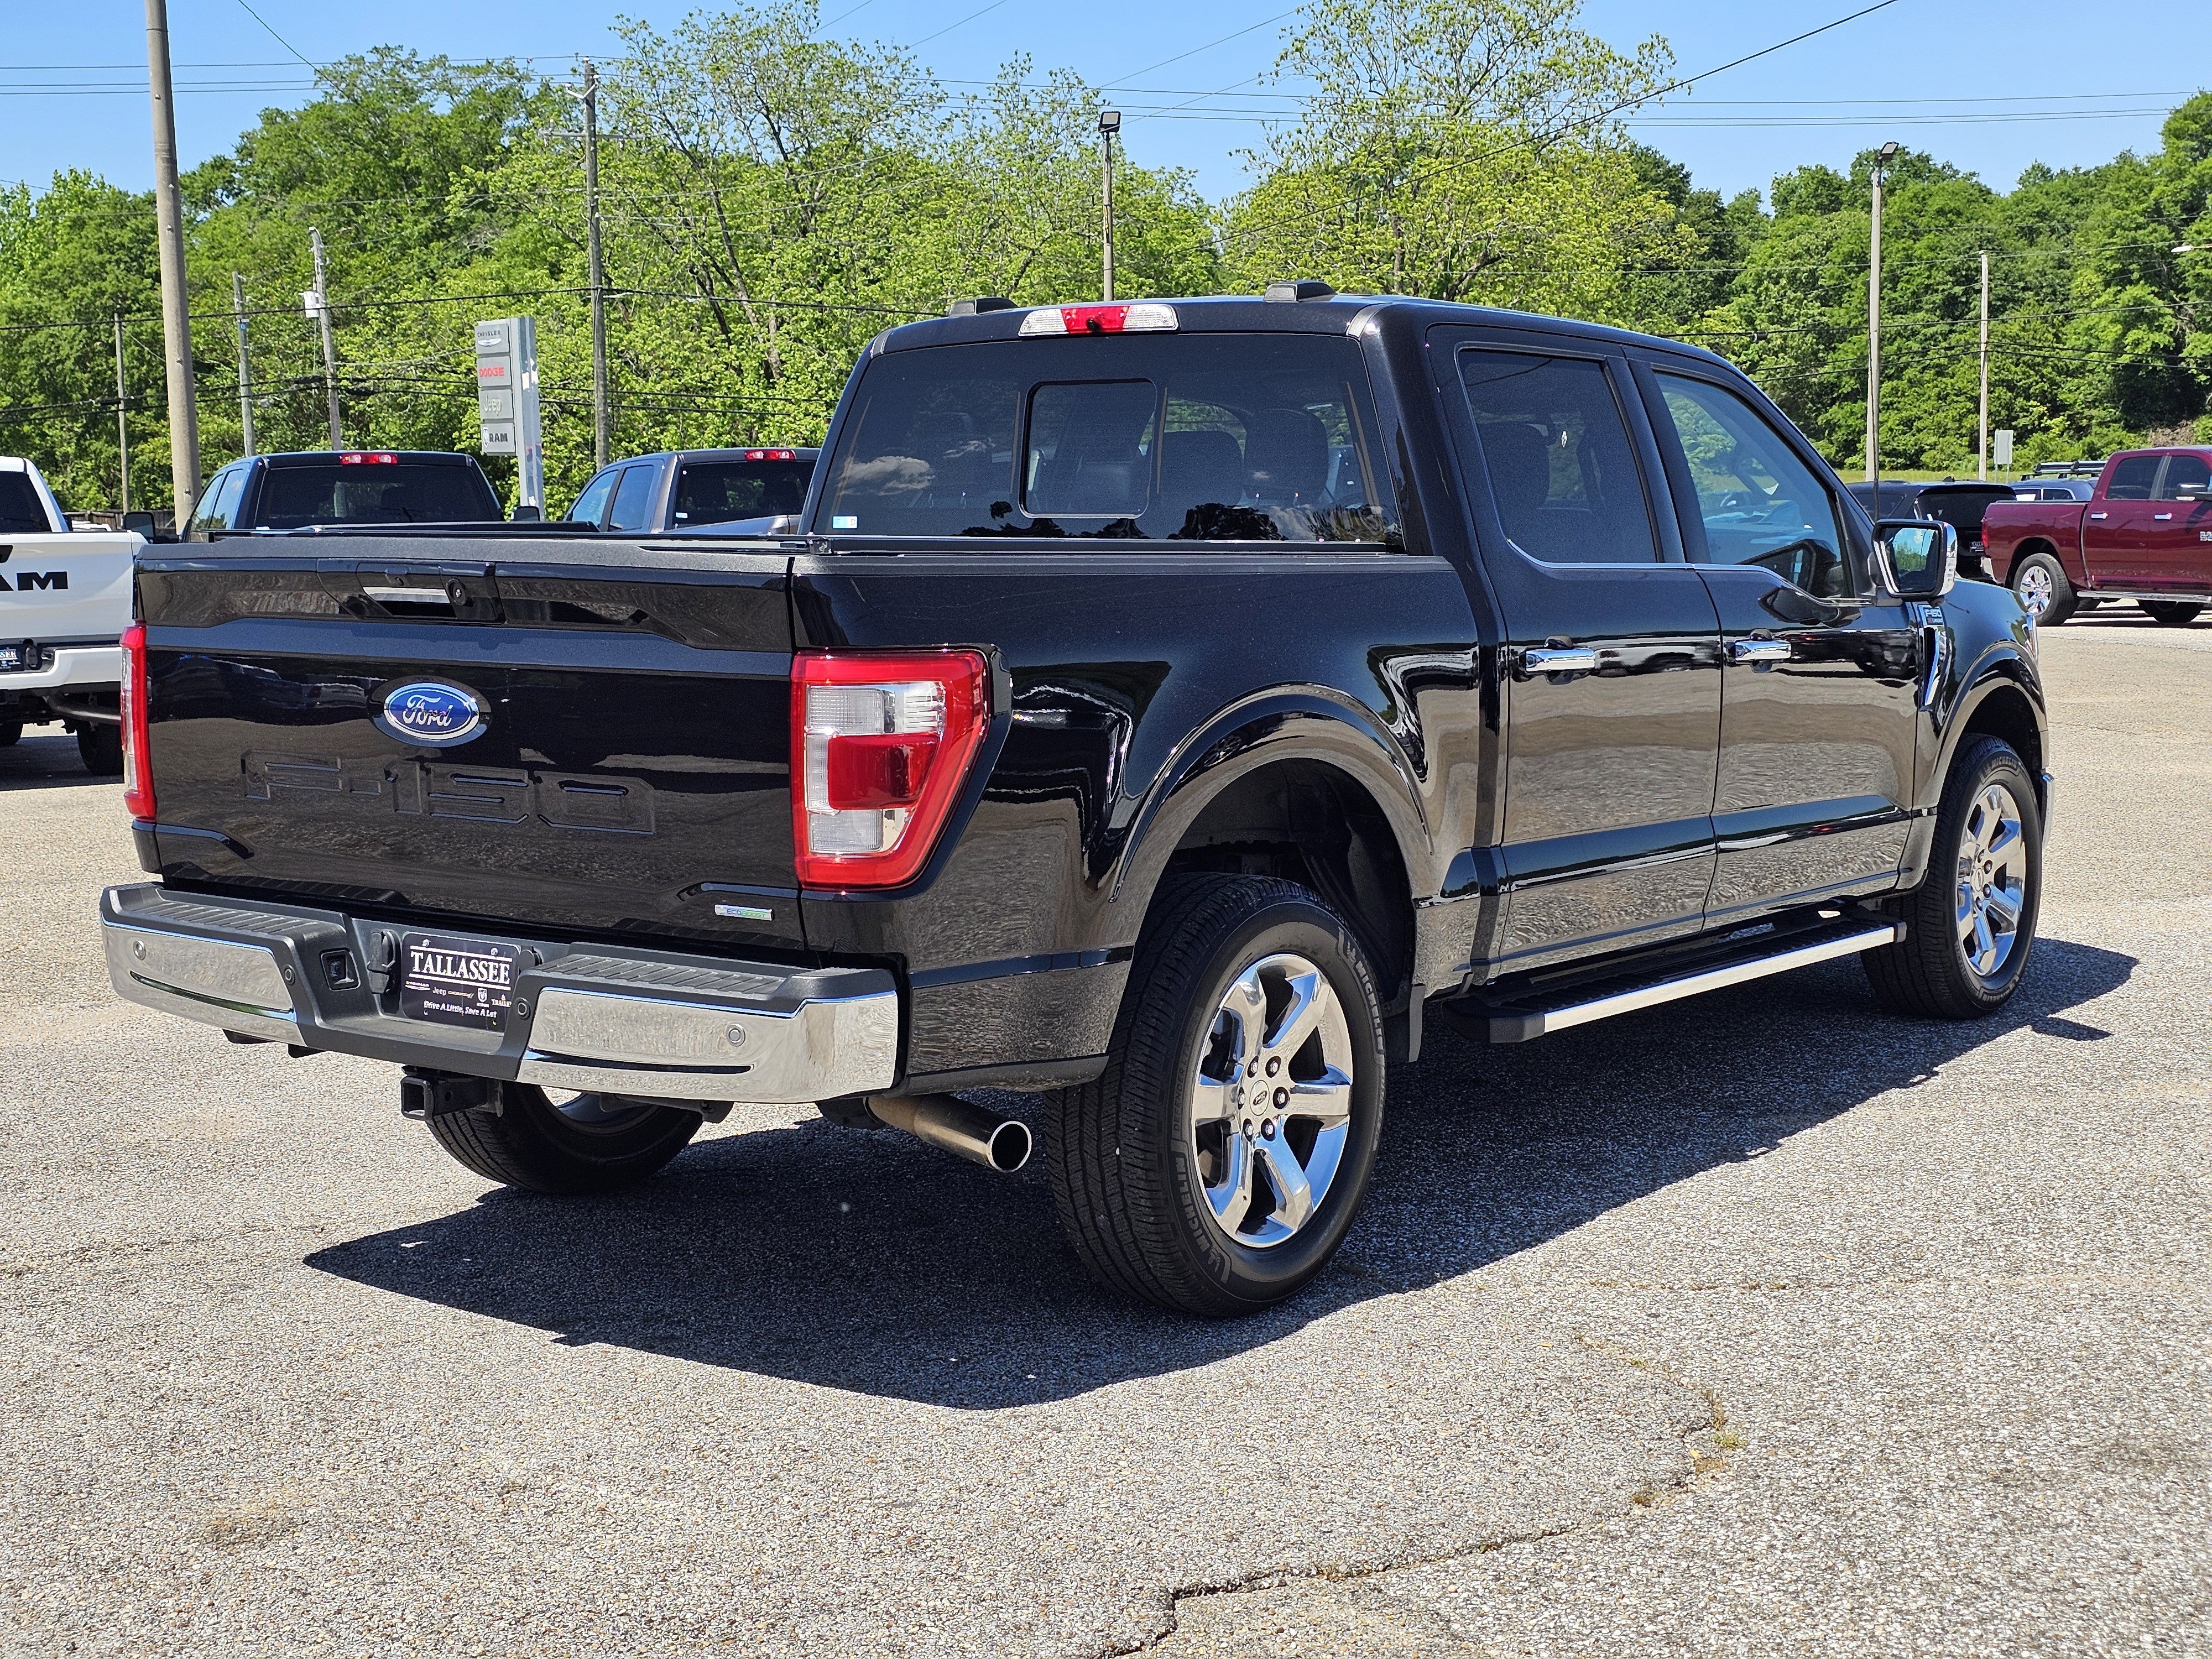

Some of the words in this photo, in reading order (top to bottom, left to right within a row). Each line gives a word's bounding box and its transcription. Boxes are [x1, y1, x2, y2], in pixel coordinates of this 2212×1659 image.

[479, 367, 504, 377] DODGE
[484, 395, 502, 416] Jeep
[489, 433, 508, 442] RAM
[402, 694, 453, 727] Ford
[241, 748, 655, 836] F-150
[411, 951, 510, 984] TALLASSEE
[432, 987, 447, 996] Jeep
[424, 1000, 440, 1010] Drive
[465, 1006, 479, 1016] Save
[486, 1010, 497, 1018] Lot
[1173, 1068, 1186, 1132] DEFENDER
[1175, 1157, 1211, 1253] MICHELIN
